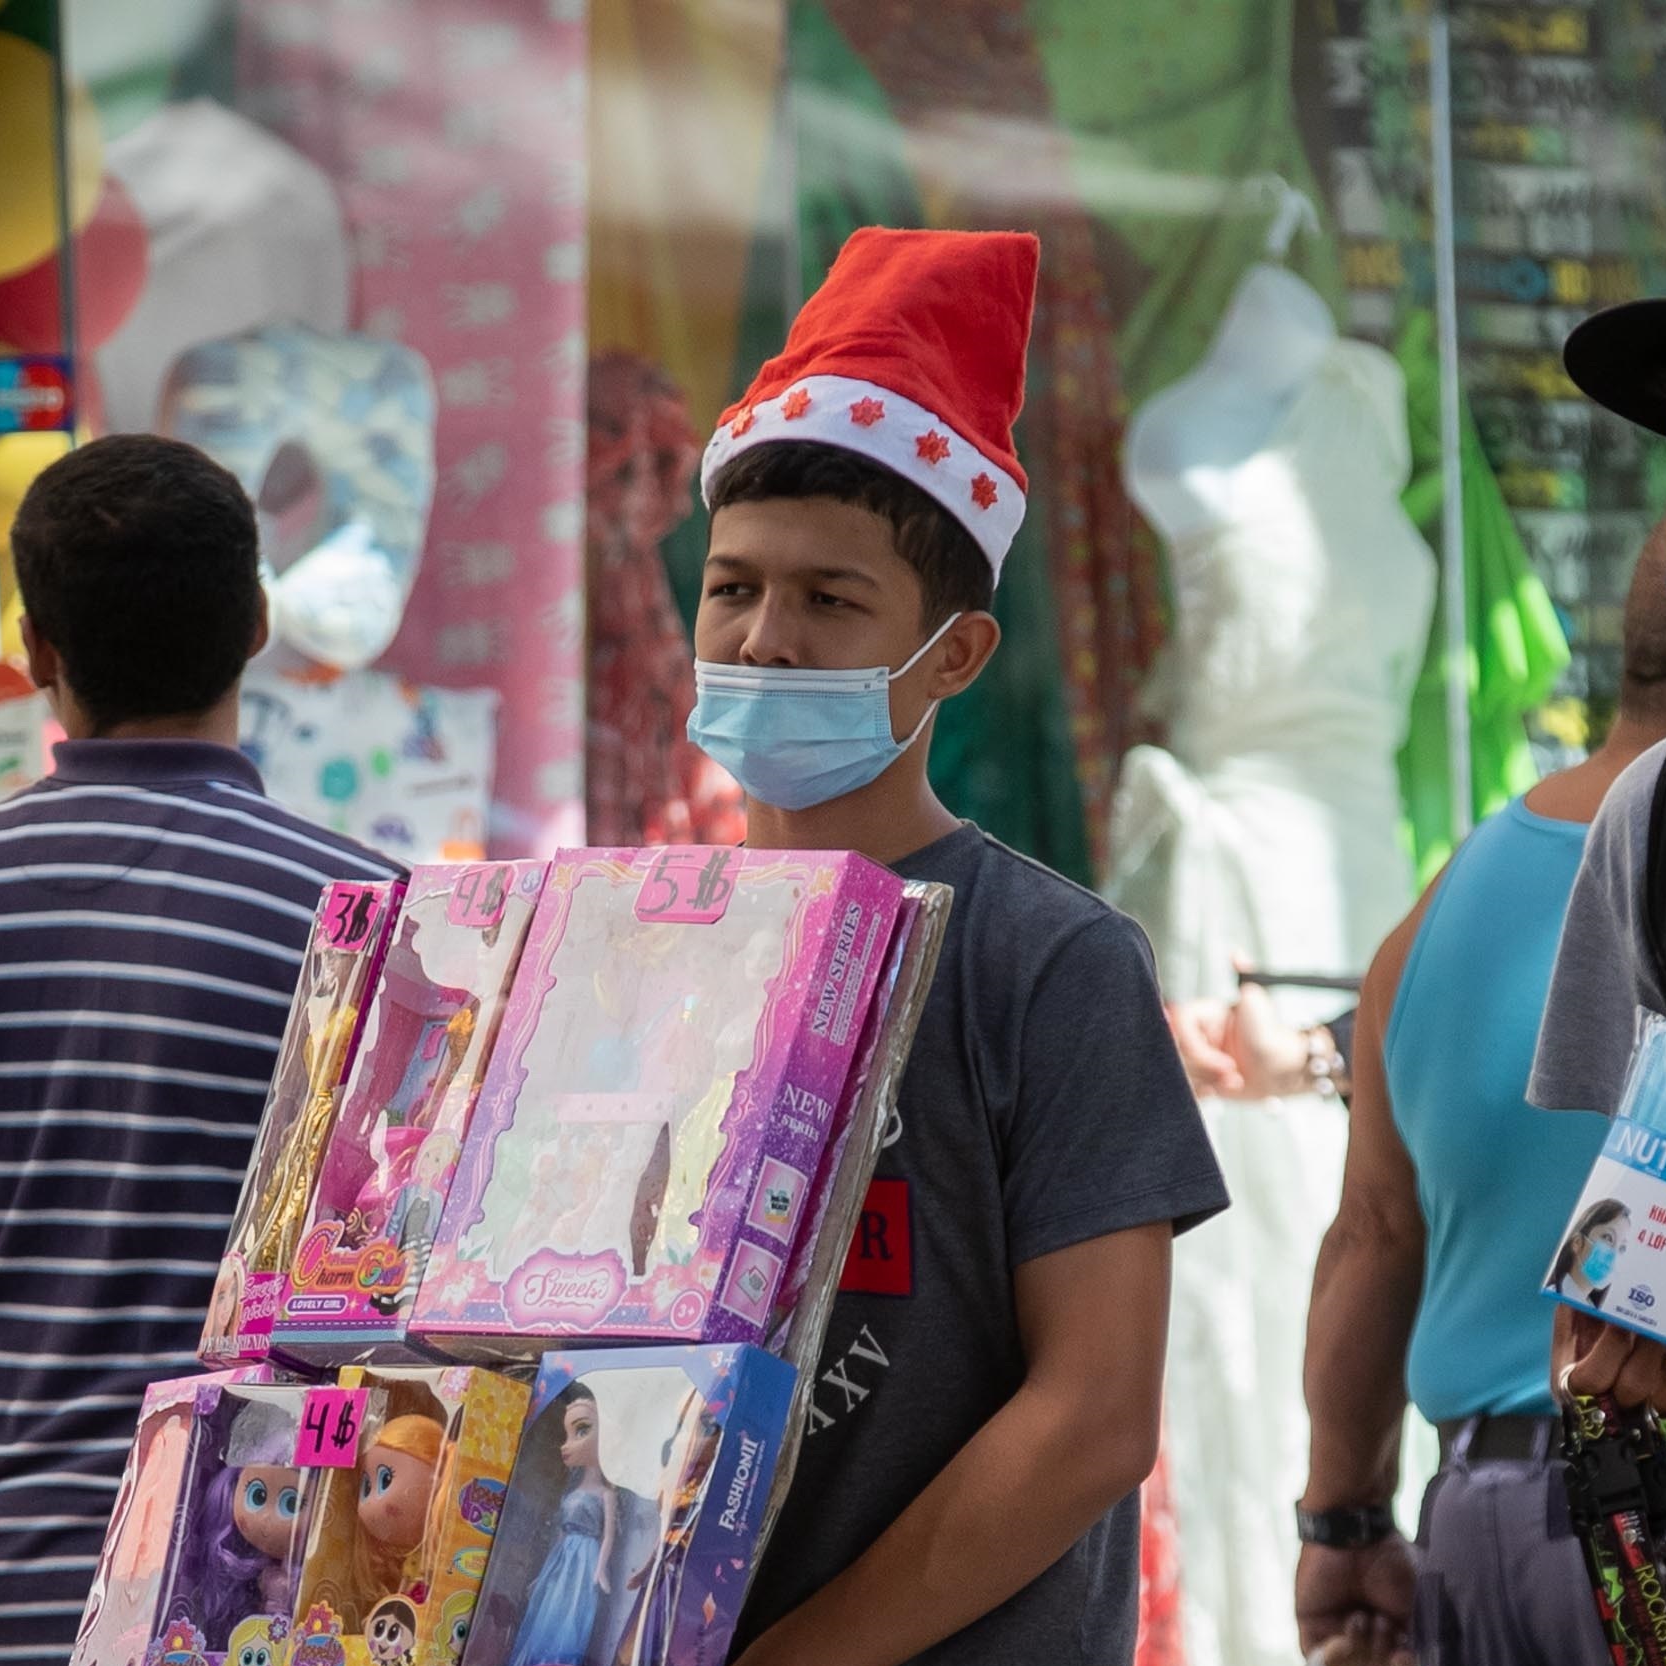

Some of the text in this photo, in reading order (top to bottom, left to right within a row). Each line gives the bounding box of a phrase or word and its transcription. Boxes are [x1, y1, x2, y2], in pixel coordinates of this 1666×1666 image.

[638, 850, 732, 914] 5$
[325, 890, 377, 945] 3$
[812, 981, 839, 1036] NEW
[830, 902, 863, 981] SERIES
[783, 1082, 833, 1123] NEW
[783, 1114, 821, 1143] SERIES
[293, 1228, 355, 1289] Charm
[291, 1298, 343, 1311] LOVELY GIRL
[1627, 1286, 1656, 1308] ISO
[710, 1351, 737, 1368] 3+
[305, 1399, 356, 1454] 4$
